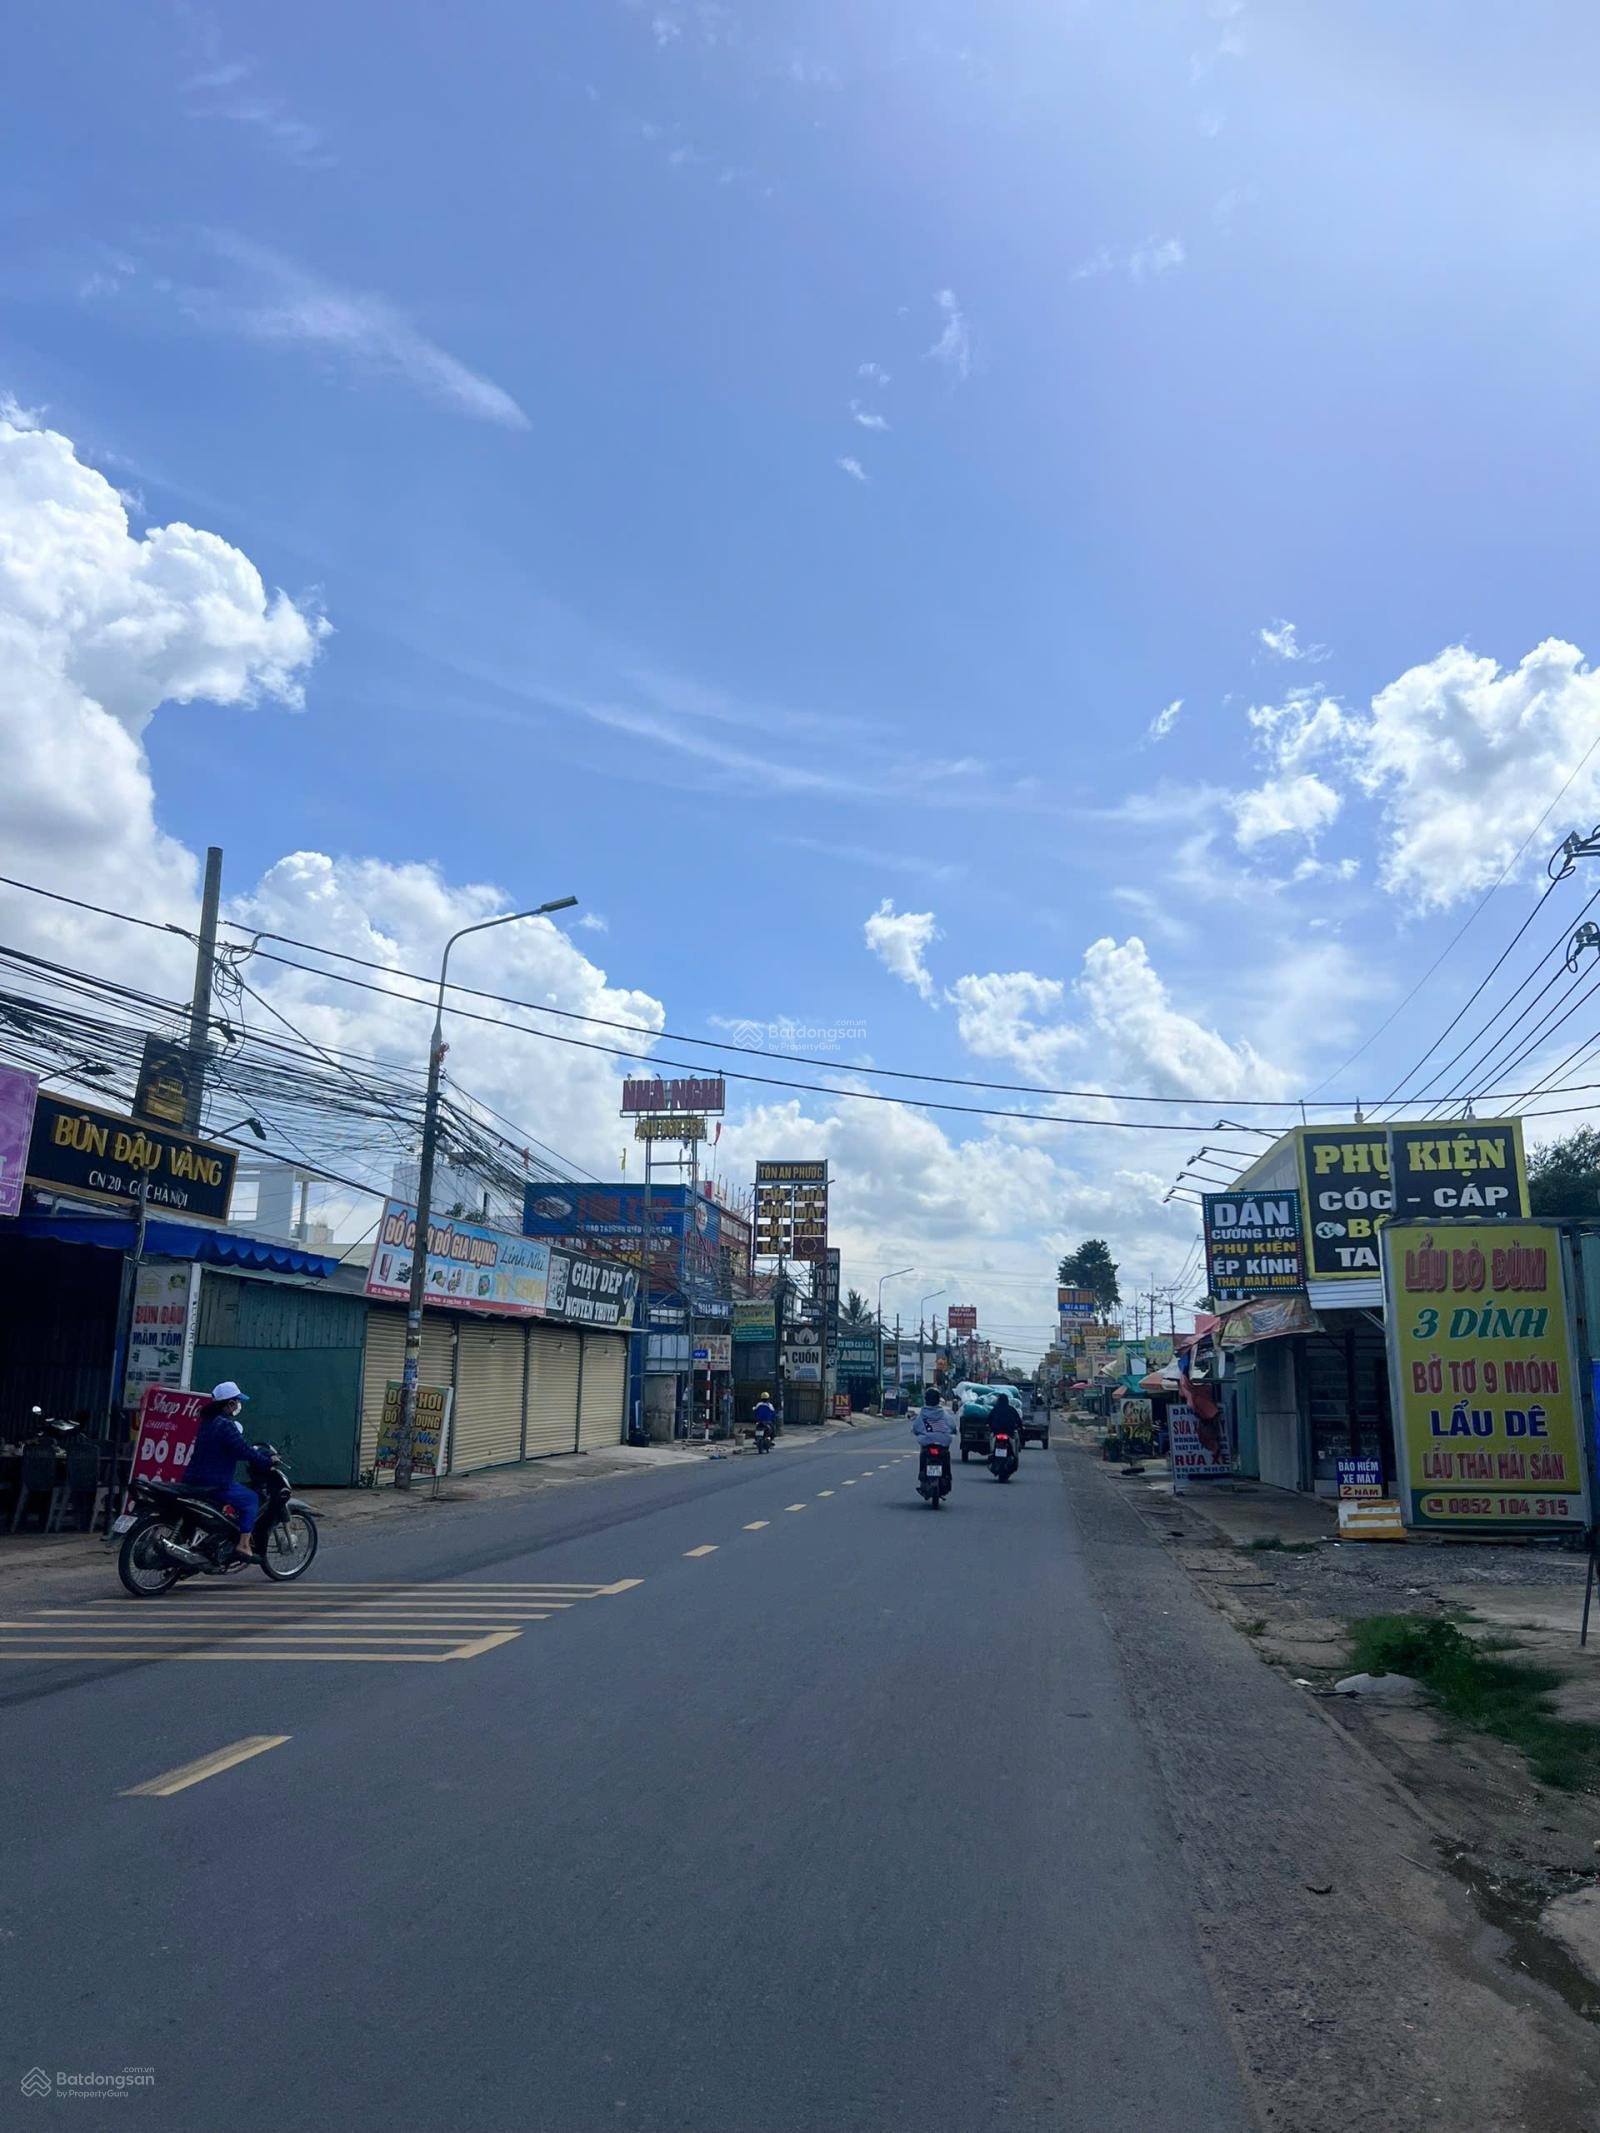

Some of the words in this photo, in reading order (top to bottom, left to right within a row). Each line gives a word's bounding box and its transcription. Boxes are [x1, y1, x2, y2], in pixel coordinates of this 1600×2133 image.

[114, 1130, 162, 1171] ĐẬU
[170, 1145, 223, 1187] VÀNG
[1313, 1143, 1391, 1180] PHỤ
[1407, 1132, 1506, 1177] KIỆN
[108, 1173, 121, 1191] 20
[779, 1167, 792, 1179] AN
[1319, 1186, 1392, 1211] CÓC
[1433, 1183, 1509, 1208] CÁP
[1214, 1197, 1290, 1227] DÁN
[1212, 1226, 1263, 1240] CƯỜNG
[1267, 1226, 1296, 1240] LỰC
[450, 1234, 470, 1262] GIA
[470, 1238, 498, 1269] DỤNG
[1212, 1243, 1249, 1256] PHỤ
[1253, 1240, 1297, 1255] KIỆN
[1213, 1257, 1240, 1275] ÉP
[1246, 1255, 1298, 1275] KÍNH
[1216, 1277, 1240, 1287] THAY
[1412, 1307, 1440, 1339] 3
[1449, 1300, 1549, 1339] DÍNH
[791, 1347, 819, 1364] CUỐN
[1448, 1359, 1478, 1394] TƠ
[1484, 1360, 1498, 1394] 9
[1504, 1353, 1560, 1394] MÓN
[149, 1393, 180, 1418] Shop
[835, 1395, 849, 1406] IN
[1430, 1399, 1494, 1437] LẨU
[1504, 1404, 1549, 1437] DÊ
[141, 1432, 169, 1463] ĐỒ
[1175, 1451, 1206, 1466] RỬA
[1211, 1454, 1230, 1465] XE
[1457, 1447, 1494, 1479] THÁI
[1342, 1474, 1354, 1484] XE
[1343, 1486, 1353, 1496] 2
[1449, 1498, 1491, 1514] 0852
[1536, 1499, 1569, 1516] 315
